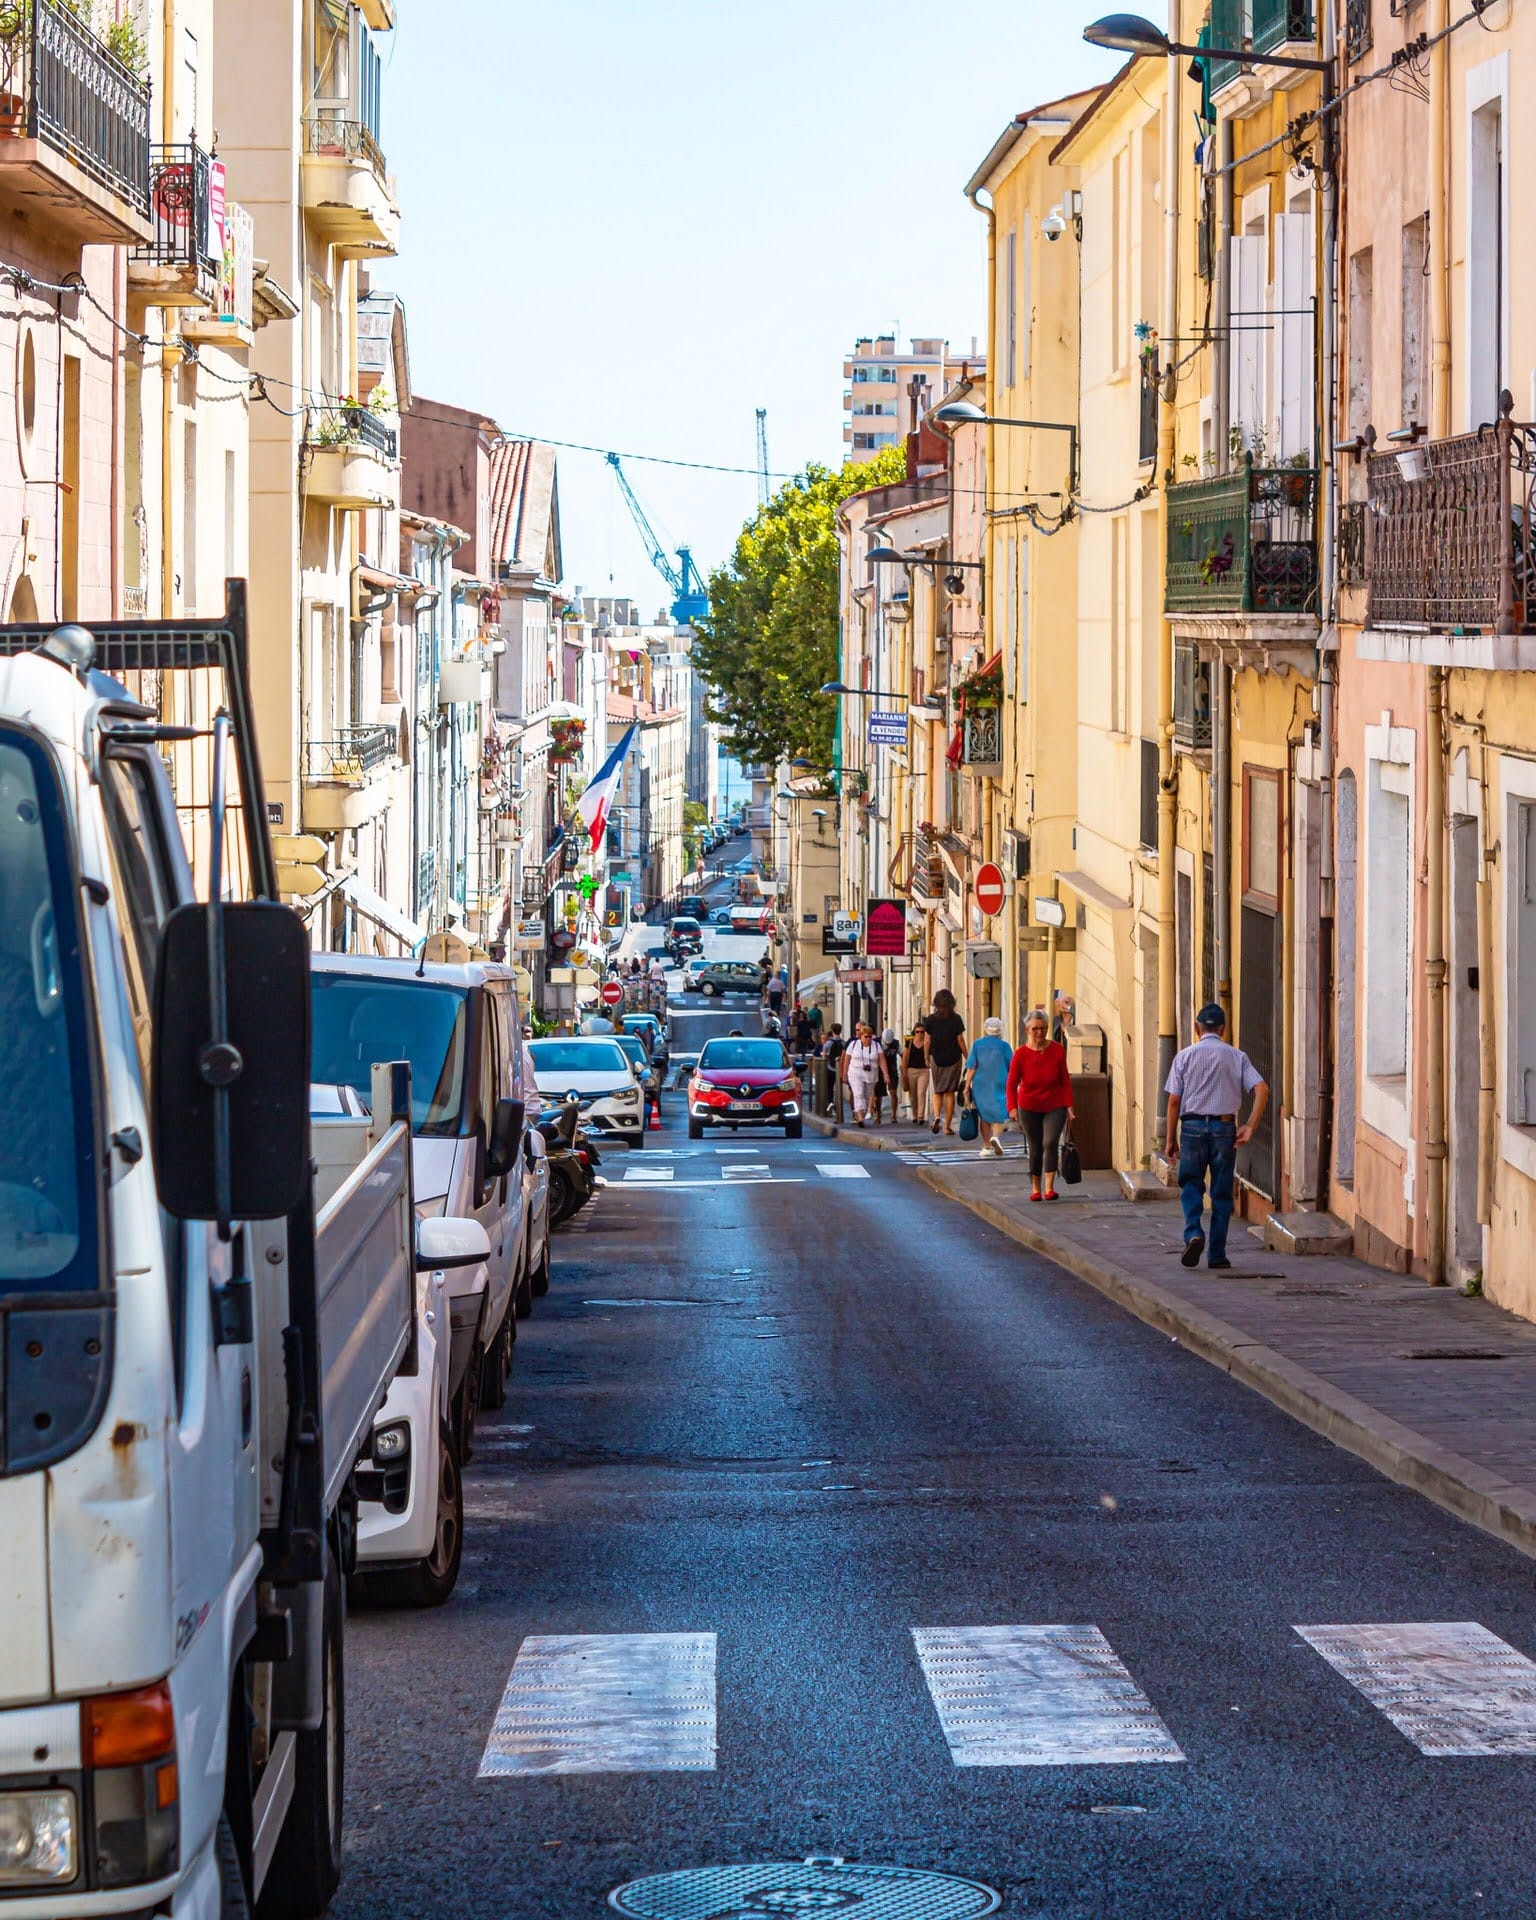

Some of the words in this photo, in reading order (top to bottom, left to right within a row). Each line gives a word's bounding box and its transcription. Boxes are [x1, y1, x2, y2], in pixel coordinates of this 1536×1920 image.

[871, 712, 907, 721] MARIANNE
[608, 911, 616, 926] 2
[836, 920, 860, 931] gan
